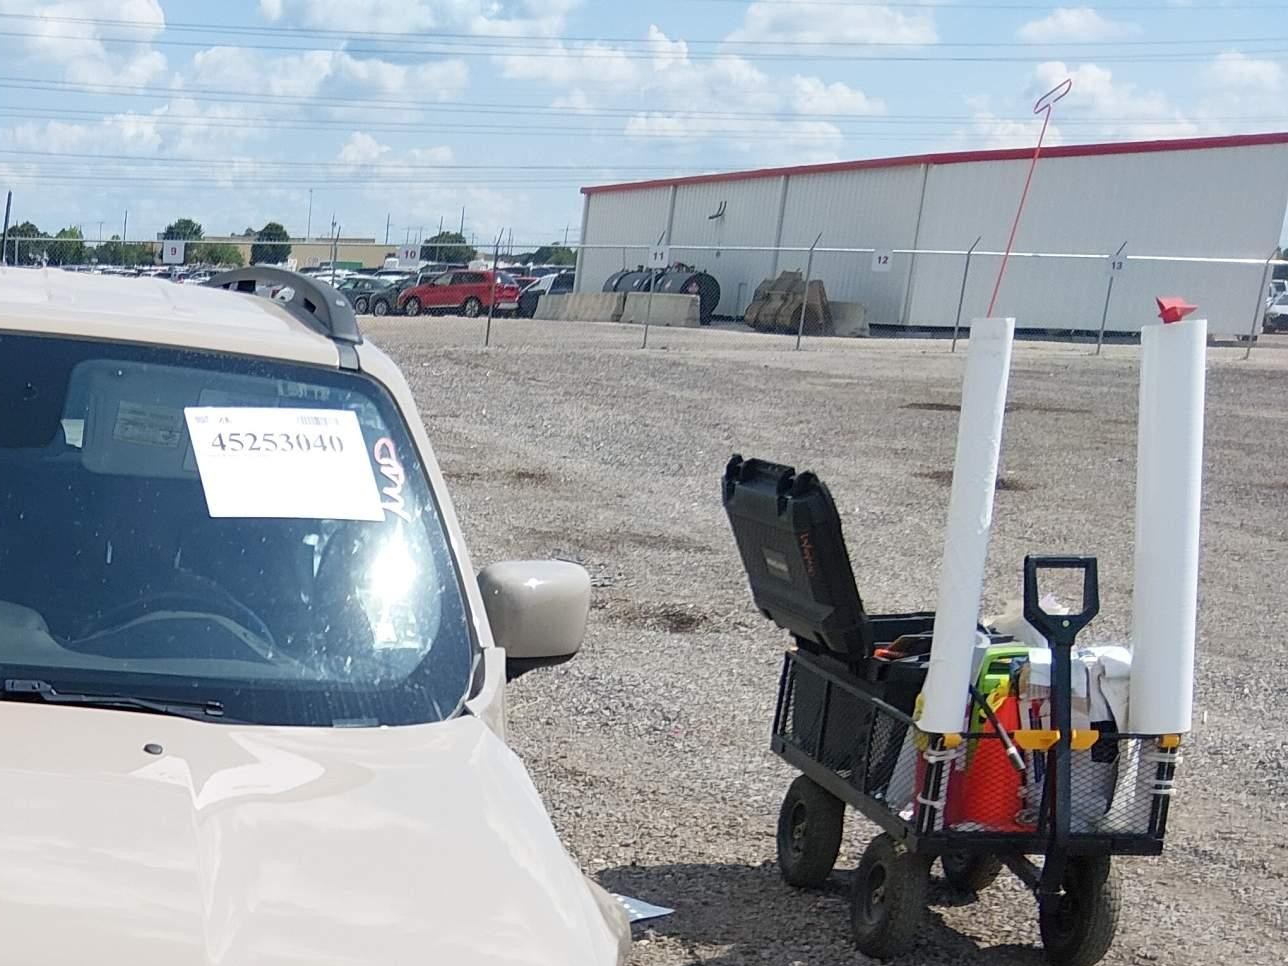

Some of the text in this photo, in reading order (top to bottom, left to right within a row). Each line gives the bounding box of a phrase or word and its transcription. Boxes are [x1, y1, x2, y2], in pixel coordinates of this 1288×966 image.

[404, 250, 416, 259] 10
[654, 251, 664, 261] 11
[878, 255, 889, 265] 12
[1112, 261, 1123, 271] 13
[211, 432, 344, 452] 45253040
